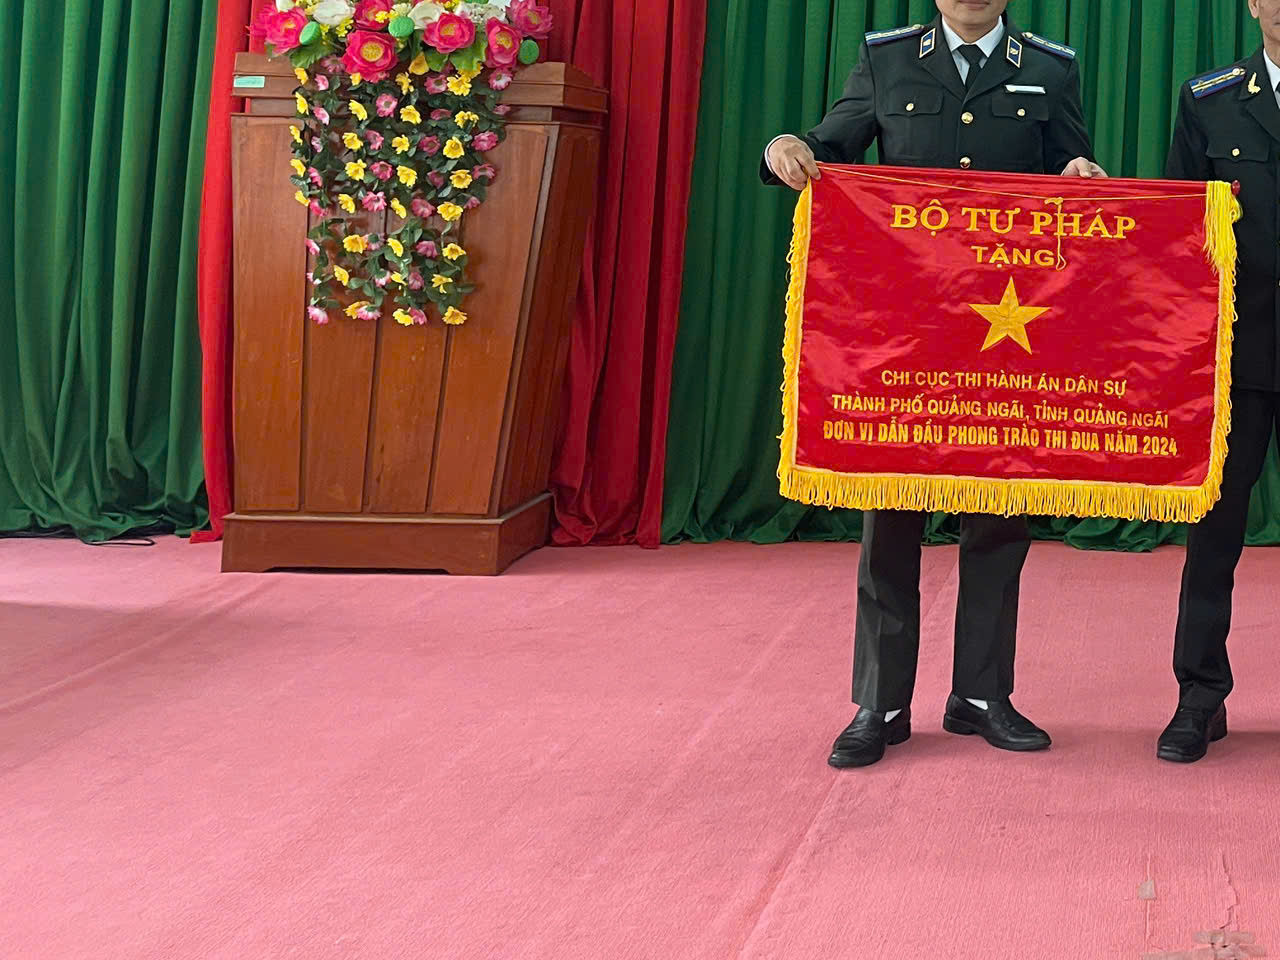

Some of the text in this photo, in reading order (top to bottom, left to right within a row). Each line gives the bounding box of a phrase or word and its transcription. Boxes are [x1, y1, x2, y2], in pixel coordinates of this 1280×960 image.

[890, 199, 1136, 239] BỘ TƯ PHÁP
[970, 243, 1055, 268] TẶNG
[881, 370, 1127, 399] CHI CỤC THI HÀNH ÁN DÂN SỰ
[832, 391, 1168, 429] THÀNH PHỐ QUẢNG NGÃI, TỈNH QUẢNG NGÃI
[823, 416, 1177, 456] ĐƠN VỊ DẪN ĐẦU PHONG TRÀO THI ĐUA NĂM 2024
